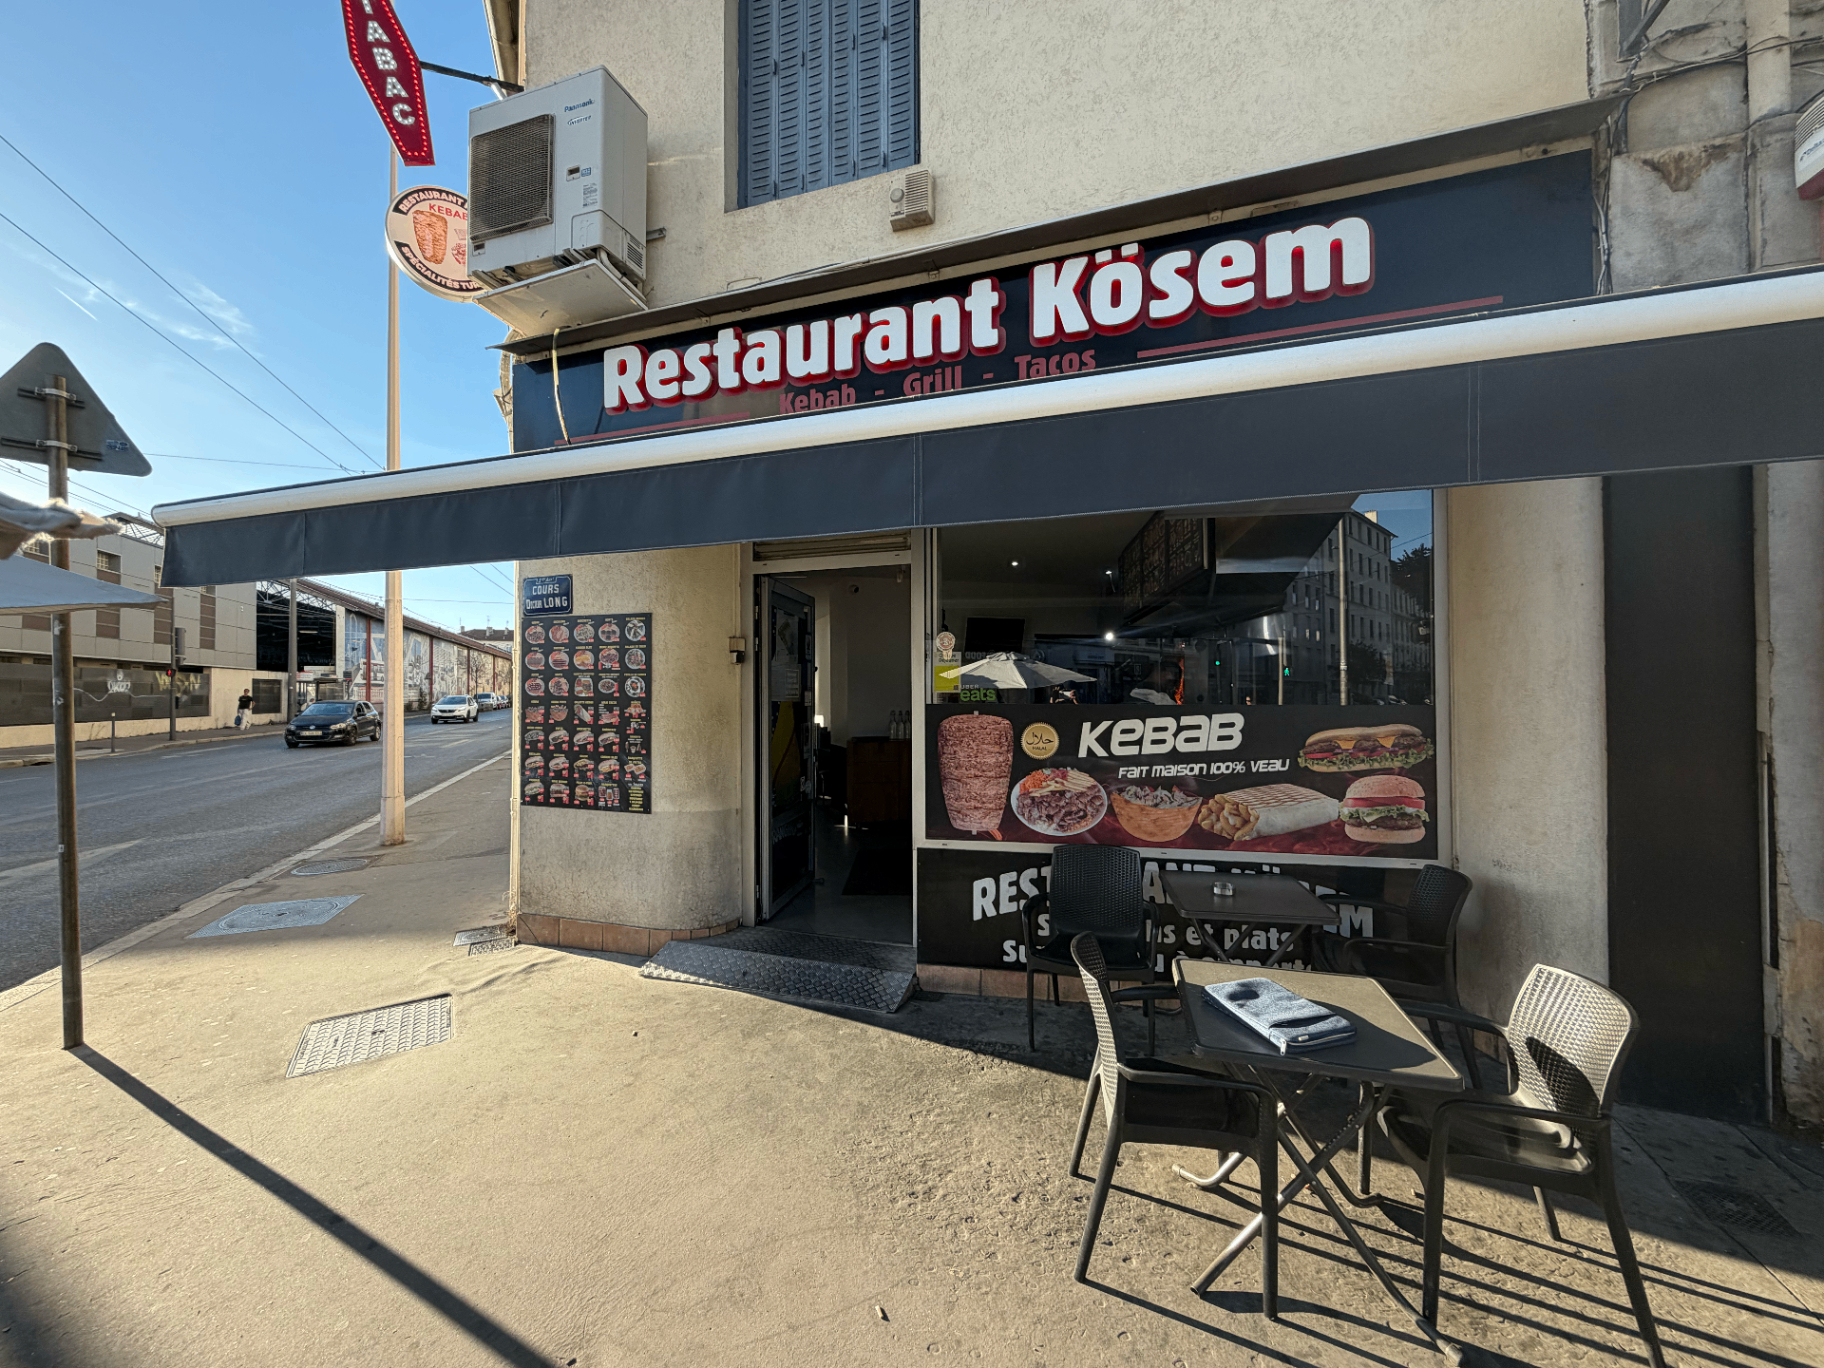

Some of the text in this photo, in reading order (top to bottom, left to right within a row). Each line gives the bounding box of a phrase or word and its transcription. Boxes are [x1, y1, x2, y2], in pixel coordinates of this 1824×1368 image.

[398, 190, 464, 213] RESTAURANT
[602, 215, 1373, 411] Restaurant Kösem
[778, 383, 856, 415] Kebab
[902, 365, 962, 398] Grill
[1013, 349, 1096, 381] Tacos
[532, 584, 560, 596] COURS
[543, 596, 568, 609] LONG
[960, 687, 996, 702] eats
[1209, 760, 1246, 775] 100%
